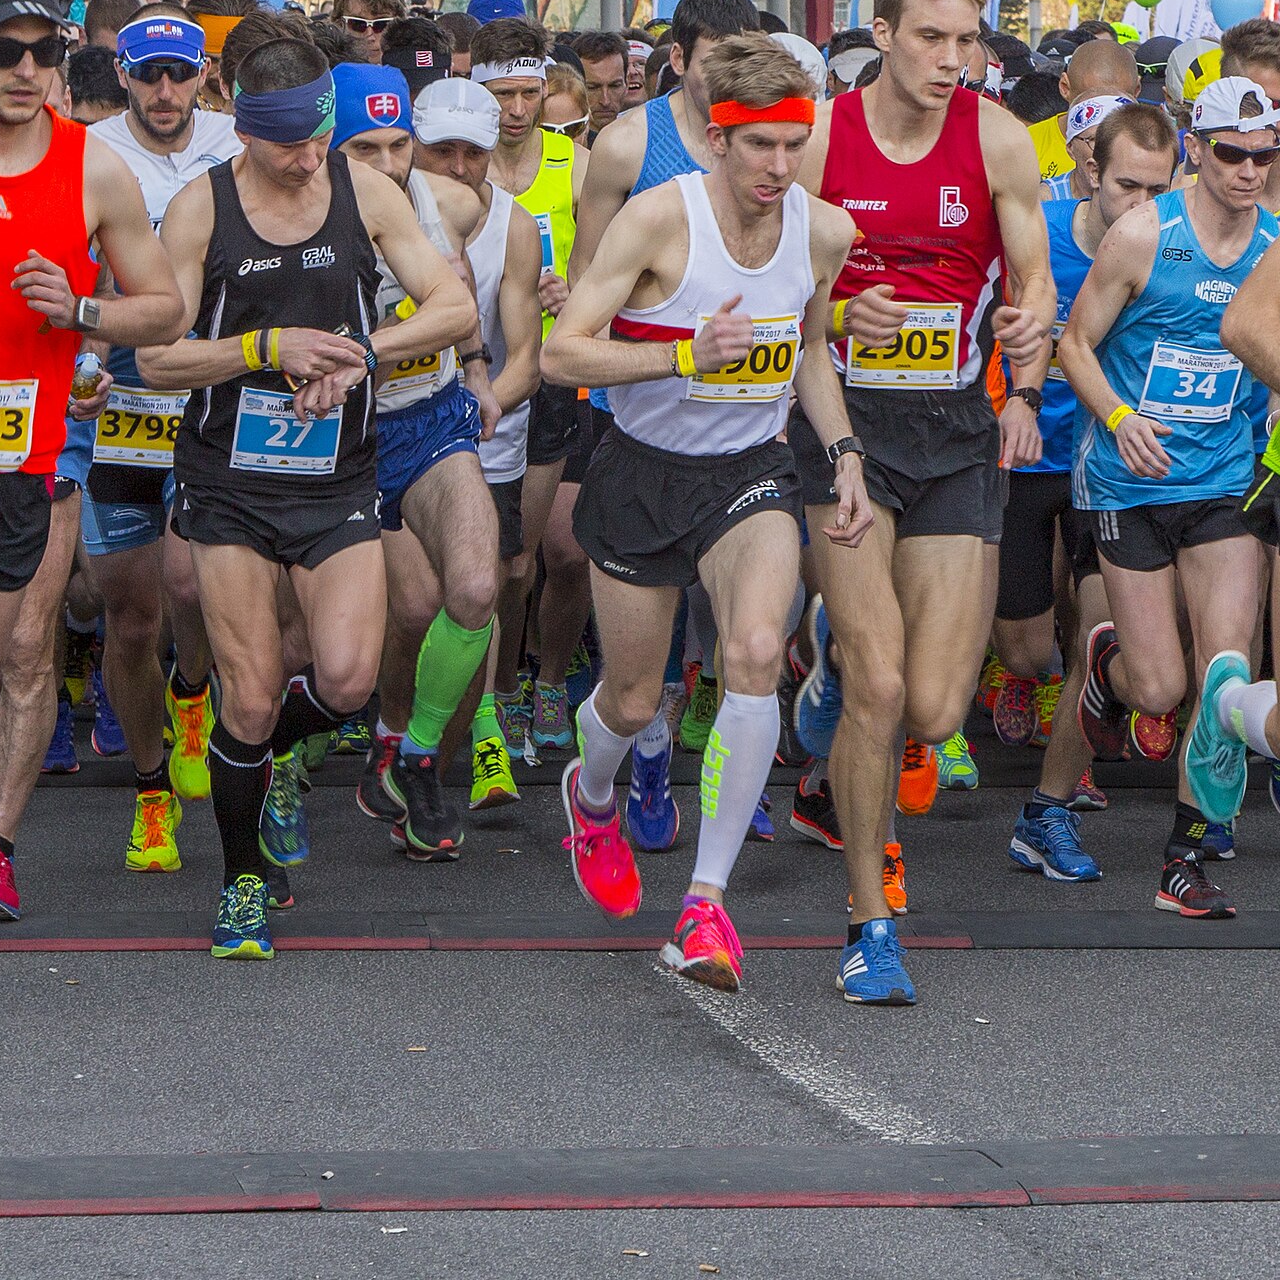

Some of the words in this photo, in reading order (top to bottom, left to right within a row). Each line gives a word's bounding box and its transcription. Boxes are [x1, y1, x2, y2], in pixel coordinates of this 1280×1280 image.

[842, 199, 888, 211] TRIMTEX
[253, 257, 282, 271] asics
[1173, 371, 1217, 399] 34
[101, 410, 181, 441] 3798
[265, 419, 314, 448] 27
